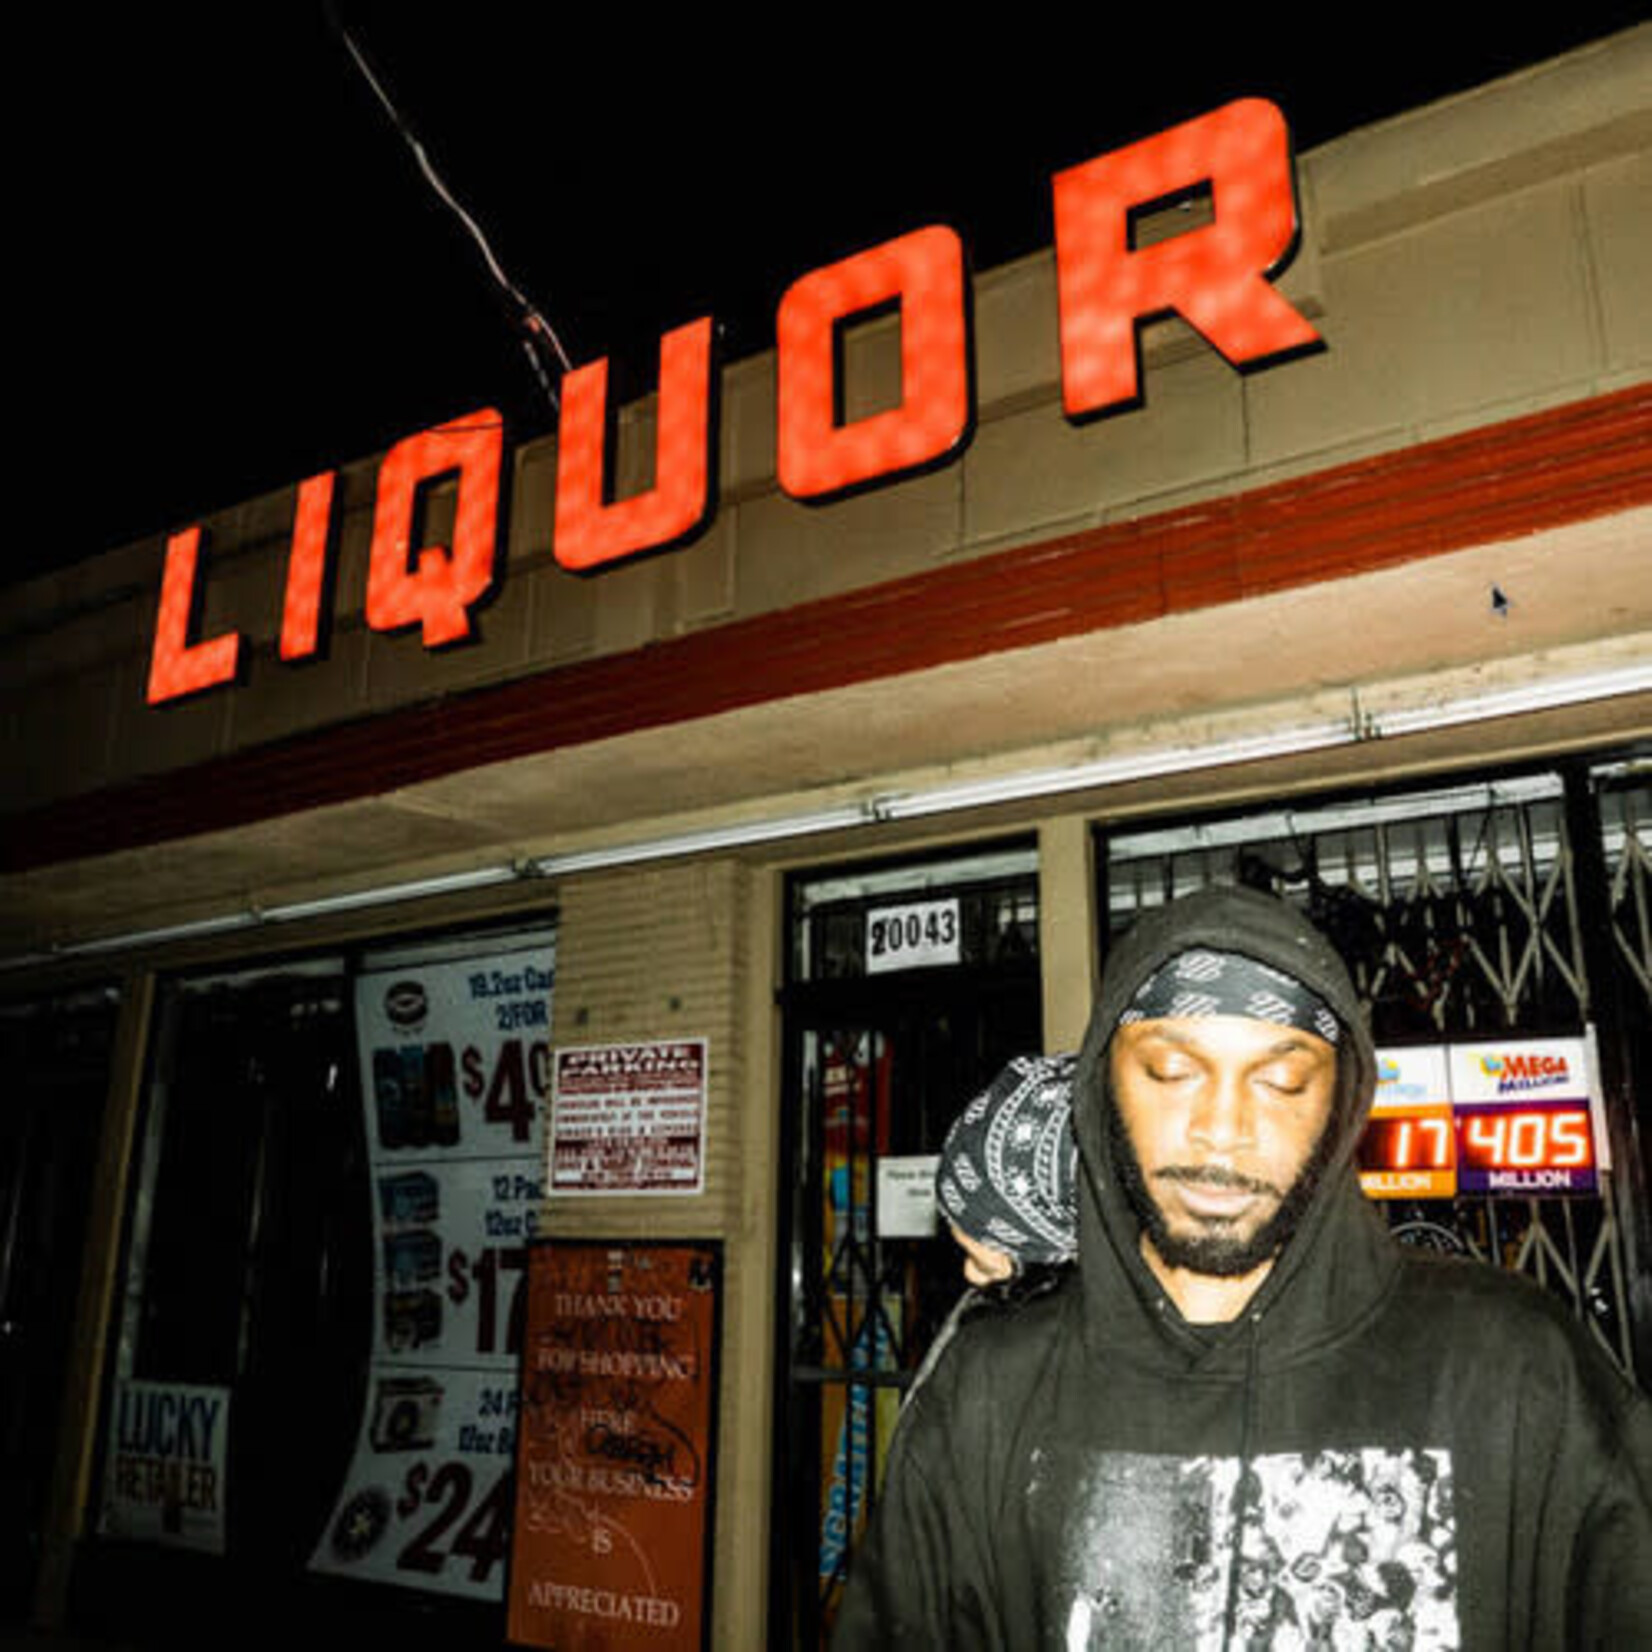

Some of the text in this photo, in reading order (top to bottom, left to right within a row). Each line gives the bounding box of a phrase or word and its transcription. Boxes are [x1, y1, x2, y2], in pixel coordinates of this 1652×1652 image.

[147, 97, 1323, 704] LIQUOR
[871, 908, 956, 957] 20043
[567, 1046, 693, 1065] PRIVATE
[1502, 1053, 1569, 1080] MEGA
[1395, 1117, 1449, 1168] 17
[1469, 1111, 1588, 1166] 405
[1489, 1170, 1571, 1188] MILLION
[554, 1293, 684, 1322] THANK YOU
[117, 1389, 220, 1461] LUCKY
[115, 1453, 216, 1512] RETAILER
[587, 1466, 697, 1502] BUSINESS
[591, 1527, 613, 1555] IS
[527, 1580, 681, 1628] APPRECIATED
